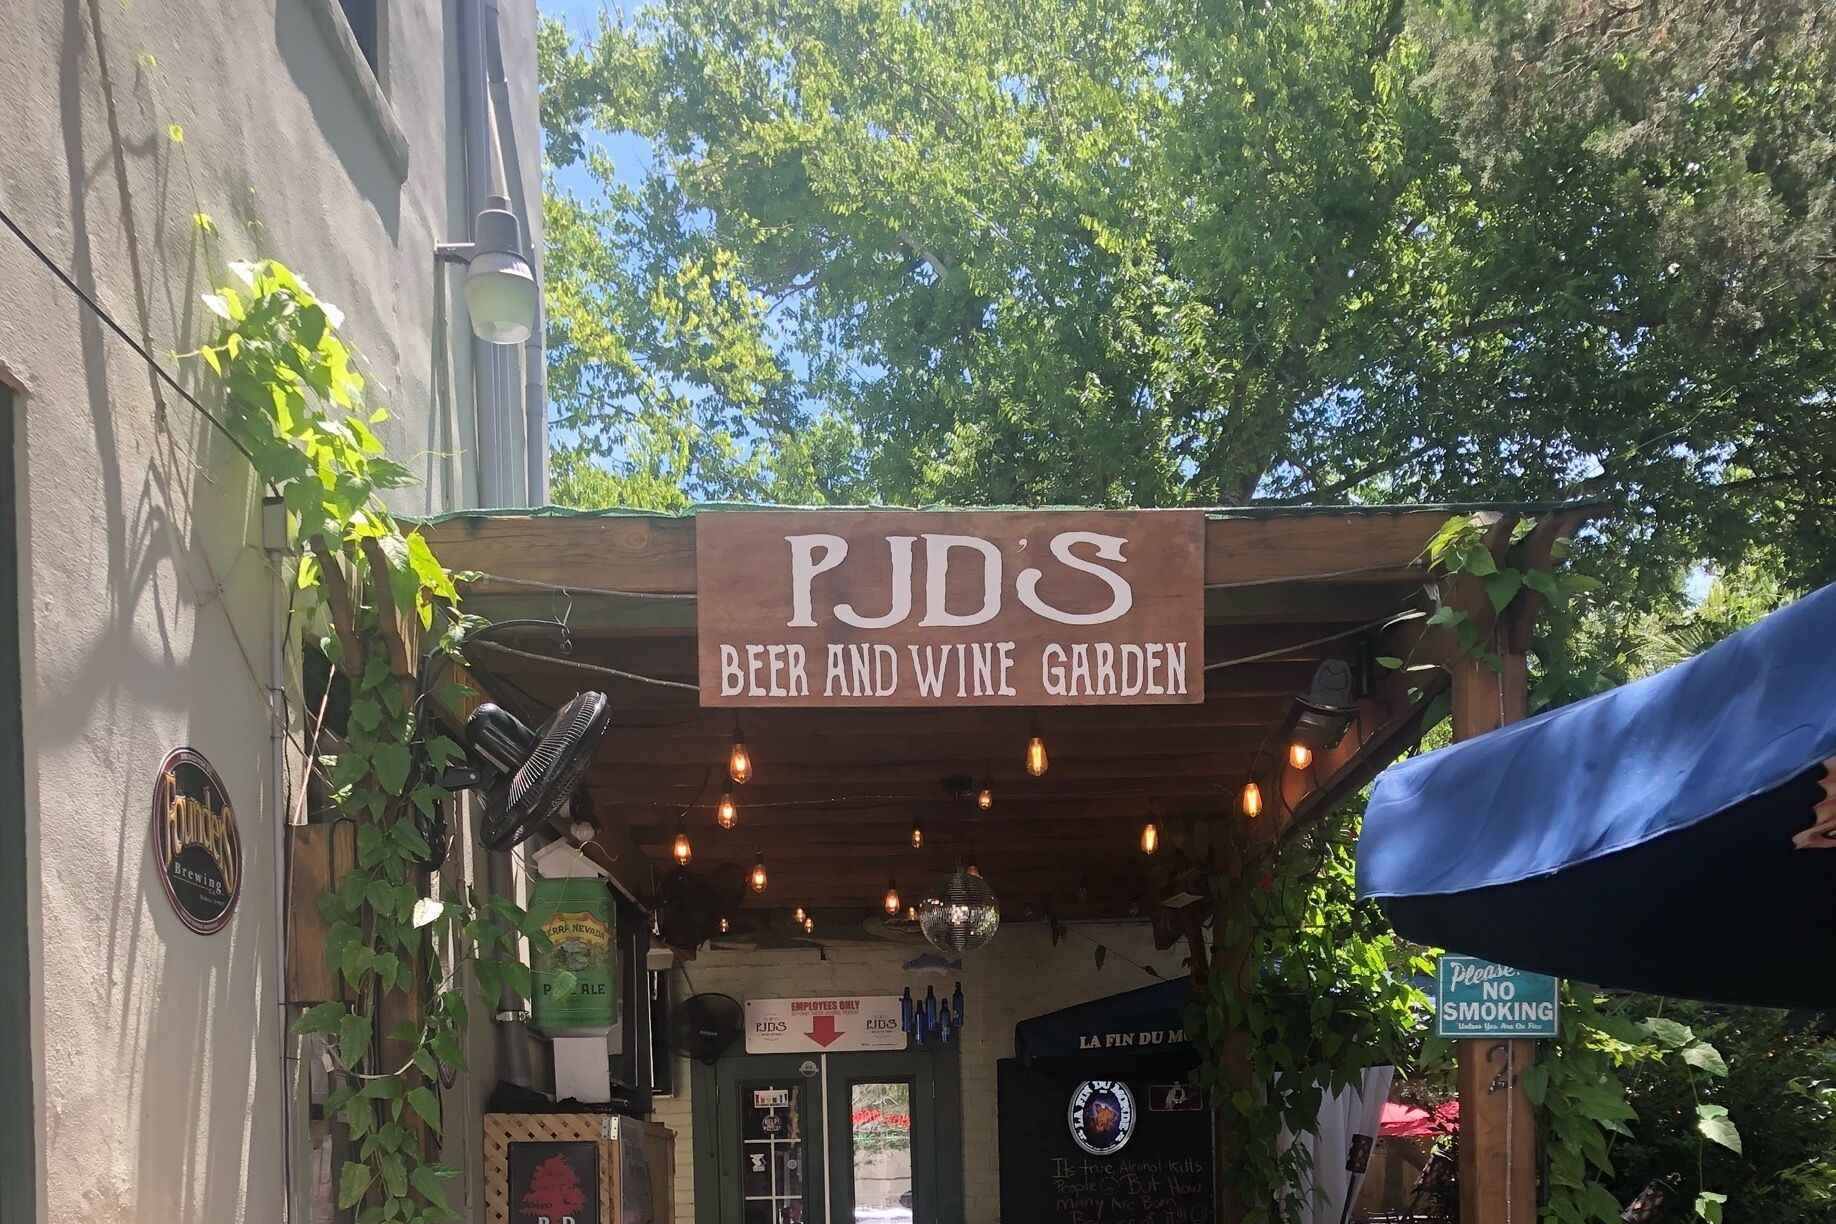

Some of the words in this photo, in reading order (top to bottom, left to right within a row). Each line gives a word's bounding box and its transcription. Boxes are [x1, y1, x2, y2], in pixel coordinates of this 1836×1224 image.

[784, 531, 1133, 629] PJD'S
[719, 643, 809, 698] BEER
[823, 642, 899, 698] AND
[908, 641, 1017, 698] WINE
[1042, 641, 1188, 698] GARDEN
[581, 983, 606, 995] ALE
[1483, 981, 1515, 1000] NO
[791, 1000, 838, 1011] EMPLOYEES
[839, 999, 860, 1010] ONLY
[1443, 1001, 1553, 1021] SMOKING
[1080, 1035, 1102, 1049] LA
[1105, 1033, 1135, 1047] FIN
[1139, 1031, 1164, 1045] DU
